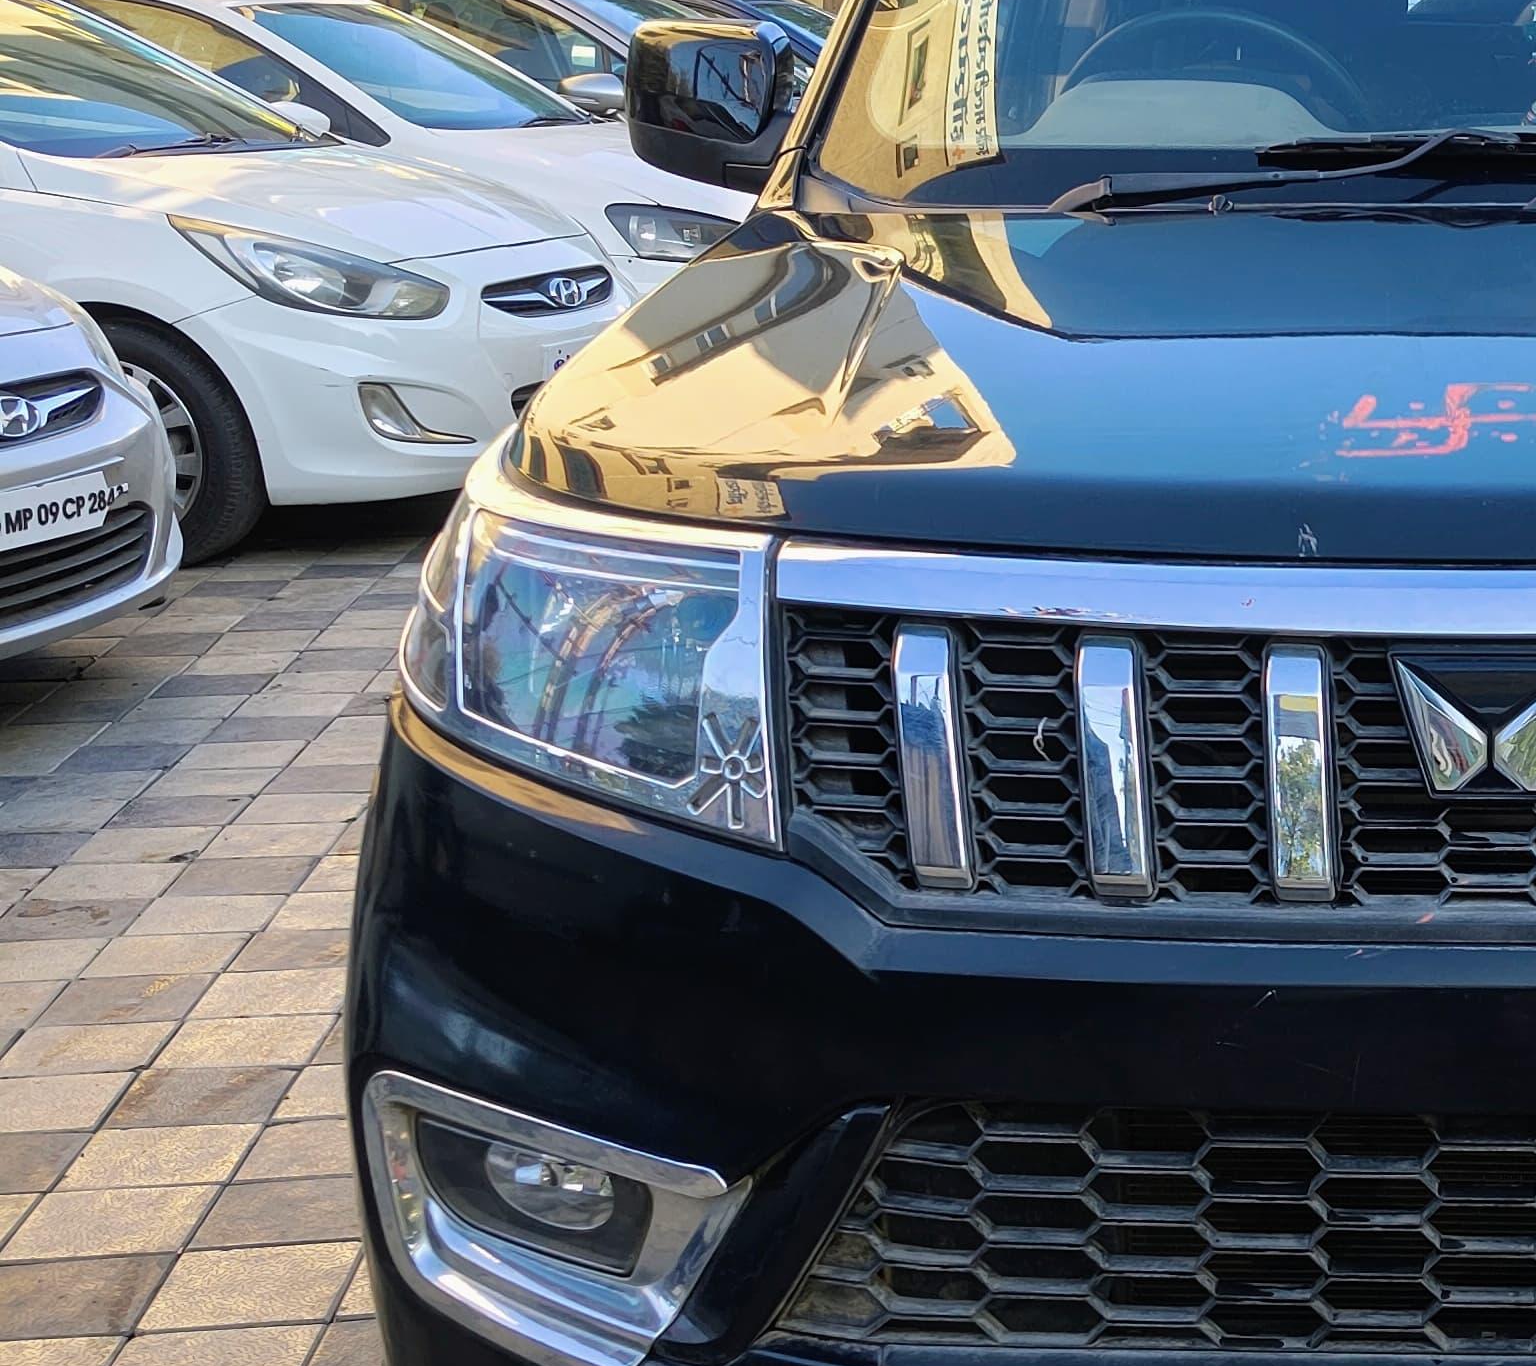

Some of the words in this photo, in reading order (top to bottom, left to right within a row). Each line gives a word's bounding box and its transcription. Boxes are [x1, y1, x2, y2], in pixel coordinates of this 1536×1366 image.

[4, 507, 33, 535] MP
[37, 501, 60, 526] 09
[62, 495, 86, 520] CP
